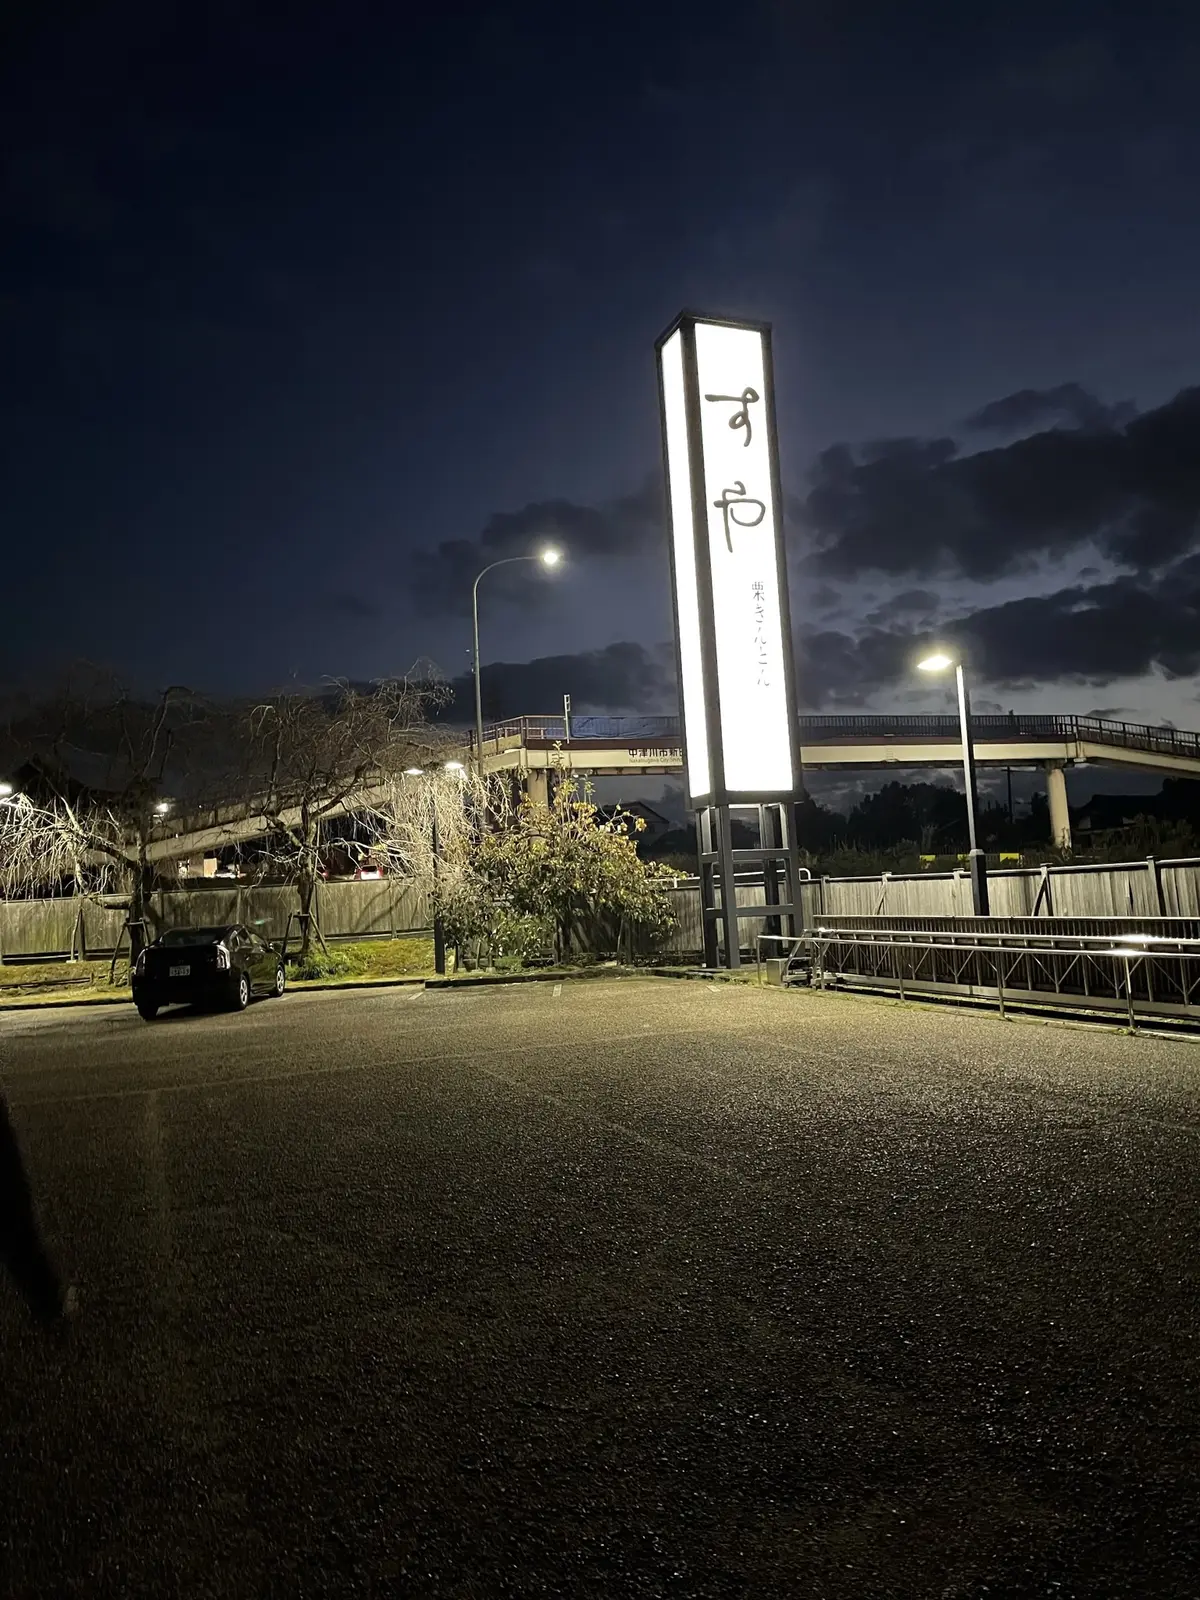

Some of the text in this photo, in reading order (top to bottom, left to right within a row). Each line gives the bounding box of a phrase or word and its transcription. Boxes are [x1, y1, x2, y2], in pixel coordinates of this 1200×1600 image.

[704, 386, 766, 553] すや
[751, 581, 770, 686] 栗きんとん
